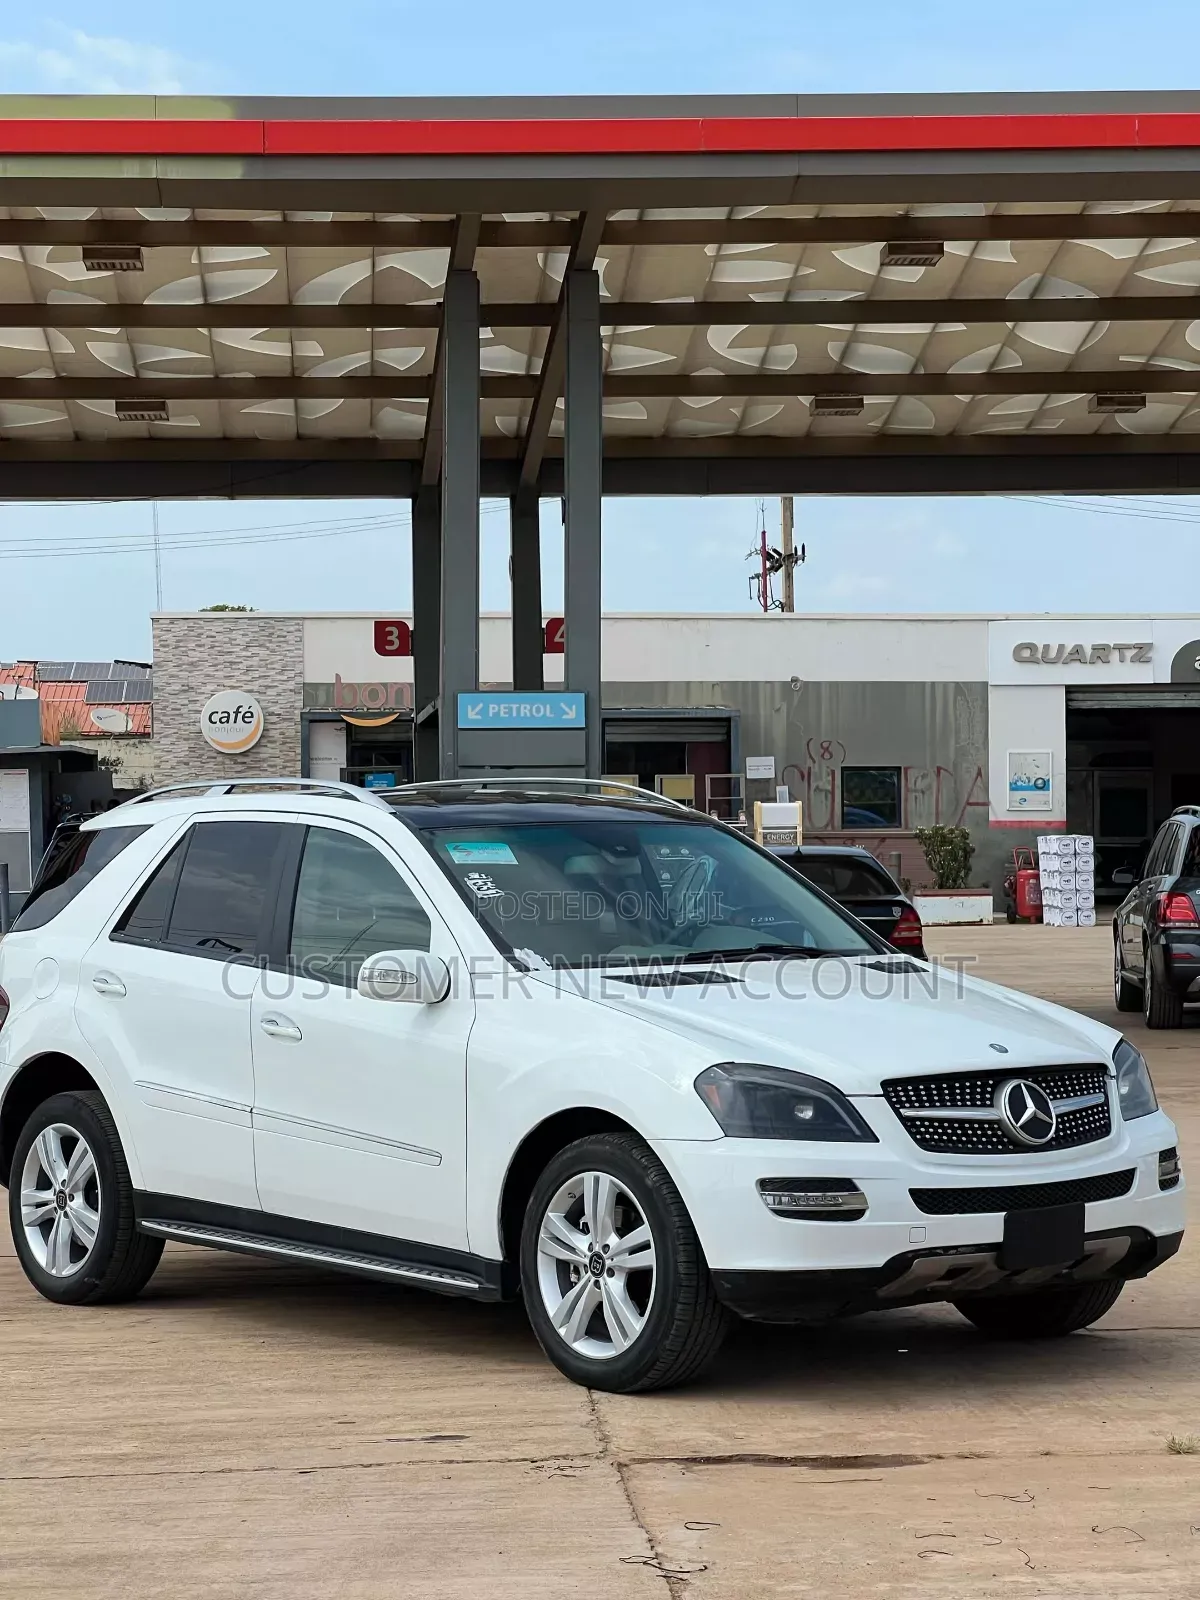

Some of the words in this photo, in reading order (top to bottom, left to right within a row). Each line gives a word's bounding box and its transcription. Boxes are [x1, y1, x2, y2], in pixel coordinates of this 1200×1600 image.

[385, 627, 400, 651] 3
[1012, 642, 1154, 664] QUARTZ
[208, 705, 255, 724] café
[488, 704, 555, 718] PETROL
[767, 833, 795, 841] ENERGY
